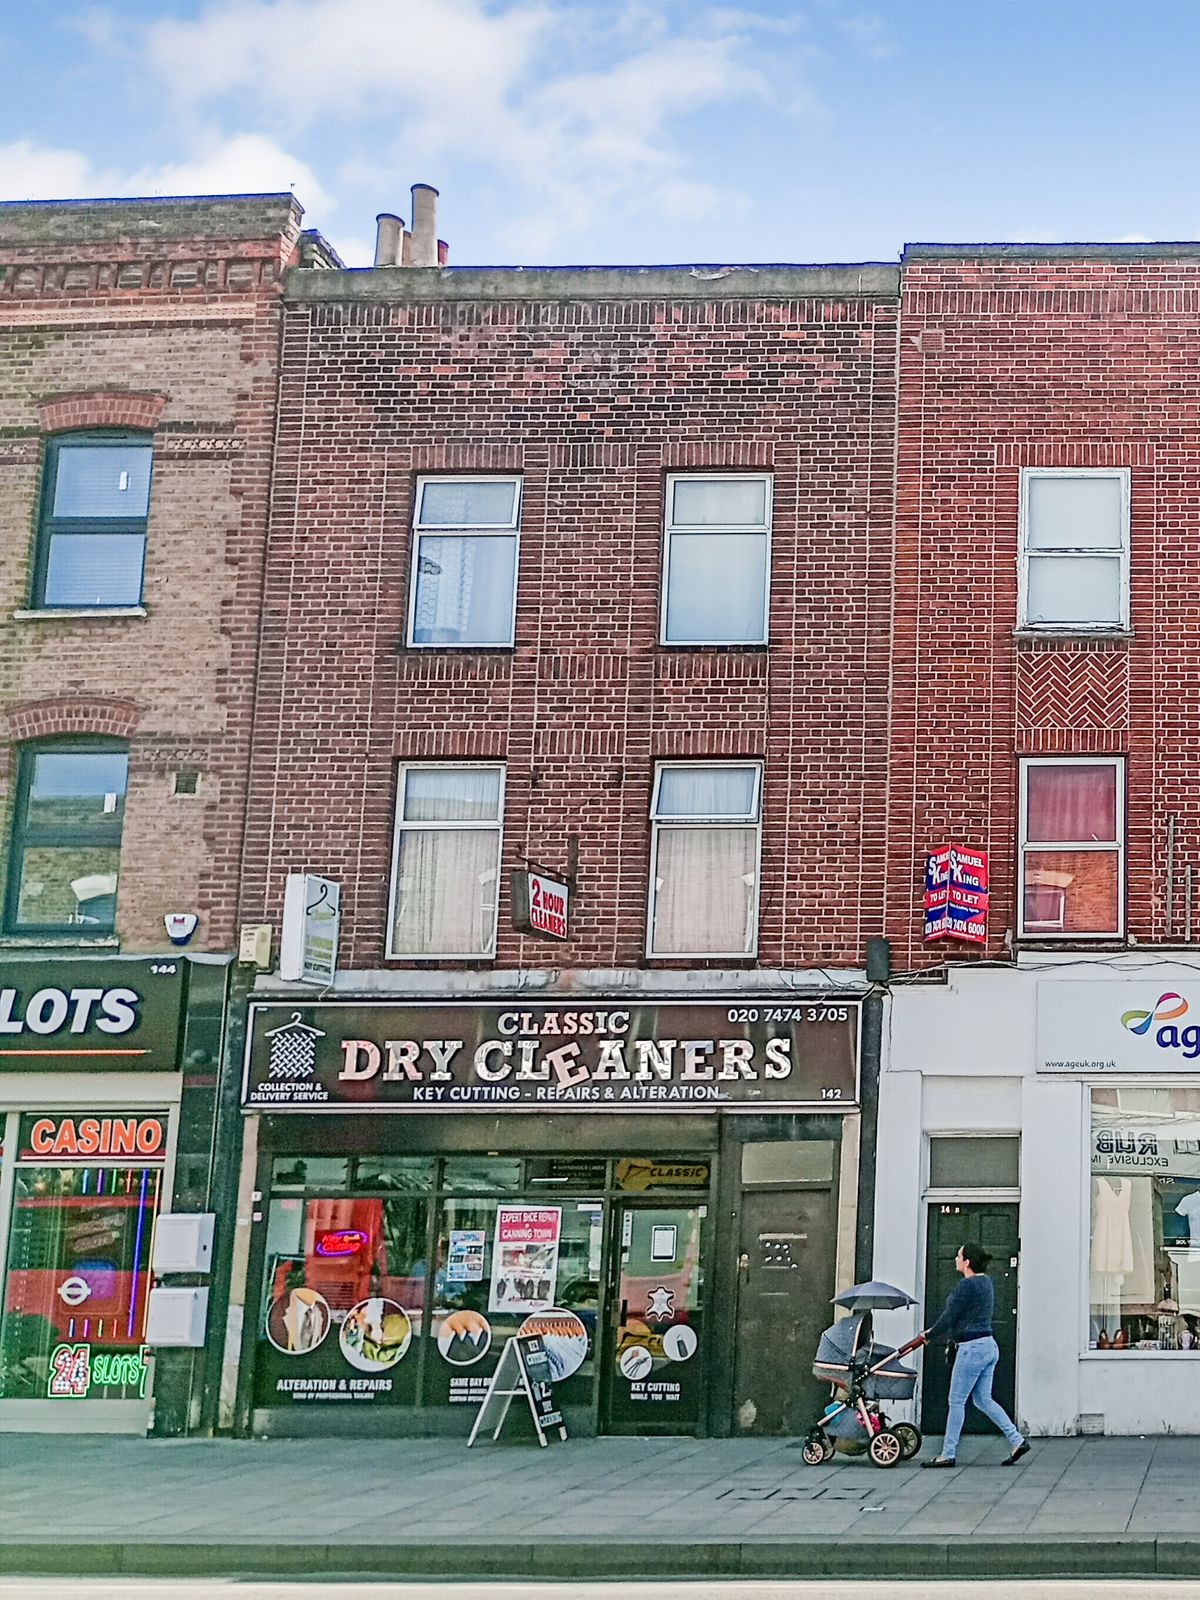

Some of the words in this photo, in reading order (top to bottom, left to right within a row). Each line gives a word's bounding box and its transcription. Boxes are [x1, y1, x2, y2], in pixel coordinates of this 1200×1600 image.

[950, 850, 984, 869] SAMUEL
[953, 863, 979, 887] KING
[532, 878, 541, 908] 2
[543, 890, 565, 916] HOUR
[952, 889, 961, 900] TO
[963, 895, 980, 905] LET
[531, 907, 566, 937] CLEANERS
[954, 918, 967, 933] 7474
[968, 921, 985, 936] 6000
[150, 964, 177, 975] 144
[727, 1008, 759, 1023] 020
[763, 1007, 803, 1022] 7474
[806, 1007, 848, 1022] 3705
[498, 1011, 631, 1036] CLASSIC
[338, 1040, 464, 1083] DRY
[473, 1037, 791, 1091] CLEANERS
[1044, 1059, 1117, 1070] www.ageuk.org.uk
[257, 1082, 313, 1092] COLLECTION
[315, 1082, 322, 1091] &
[413, 1087, 445, 1100] KEY
[450, 1086, 520, 1100] CUTTING
[536, 1086, 600, 1100] REPAIRS
[604, 1087, 615, 1100] &
[619, 1086, 720, 1100] ALTERATION
[821, 1088, 842, 1100] 142
[250, 1091, 292, 1101] DELIVERY
[293, 1091, 329, 1101] SERVICE
[31, 1118, 163, 1154] CASINO
[650, 1167, 702, 1177] CLASSIC
[501, 1212, 522, 1223] EXPERT
[523, 1212, 538, 1223] SHOE
[502, 1228, 533, 1239] CANNING
[534, 1228, 552, 1240] TOWN
[50, 1346, 90, 1395] 24
[92, 1355, 140, 1385] SLOTS
[276, 1379, 337, 1391] ALTERATION
[338, 1379, 347, 1391] &
[349, 1379, 393, 1391] REPAIRS
[631, 1382, 647, 1392] KEY
[647, 1382, 680, 1392] CUTTING
[651, 1393, 663, 1401] YOU
[665, 1393, 680, 1401] WAIT
